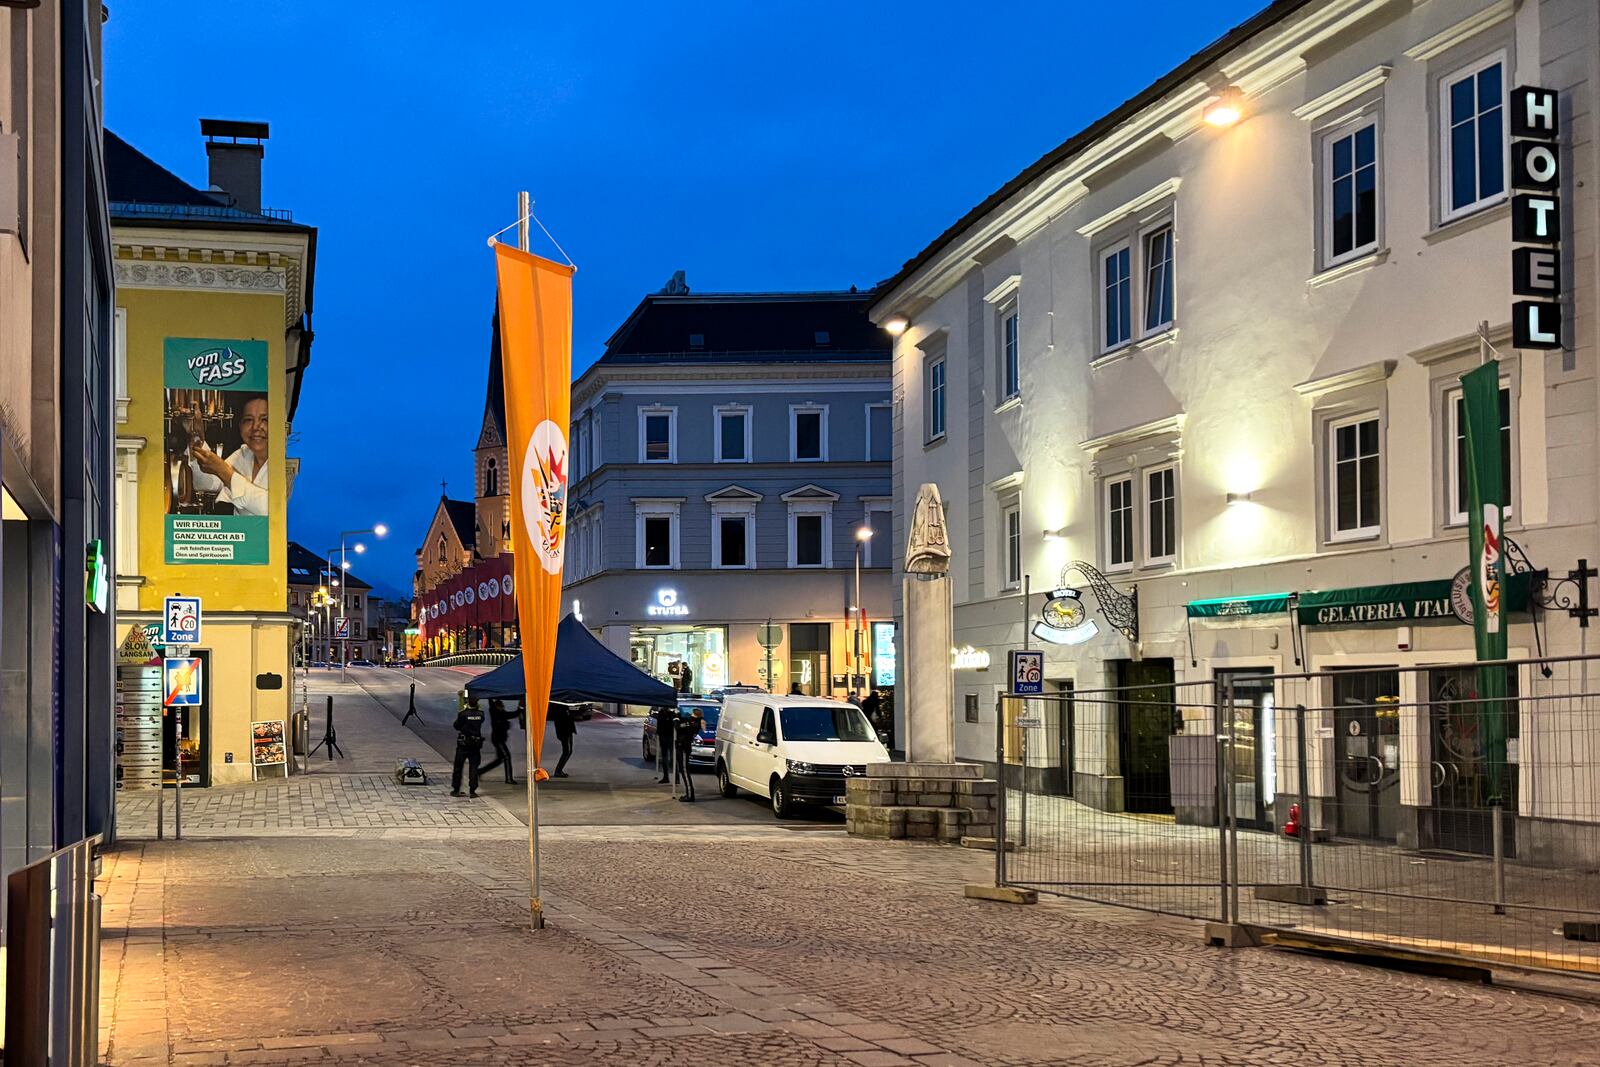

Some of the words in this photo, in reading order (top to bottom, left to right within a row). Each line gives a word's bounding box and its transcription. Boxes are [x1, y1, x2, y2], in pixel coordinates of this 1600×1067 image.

[1526, 92, 1556, 344] HOTEL
[187, 352, 219, 370] vom
[198, 358, 245, 384] FASS
[1317, 600, 1407, 624] GELATERIA
[184, 620, 195, 629] 20
[172, 632, 194, 641] Zone
[124, 642, 148, 651] SLOW
[1030, 672, 1039, 680] 20
[1018, 684, 1038, 692] Zone
